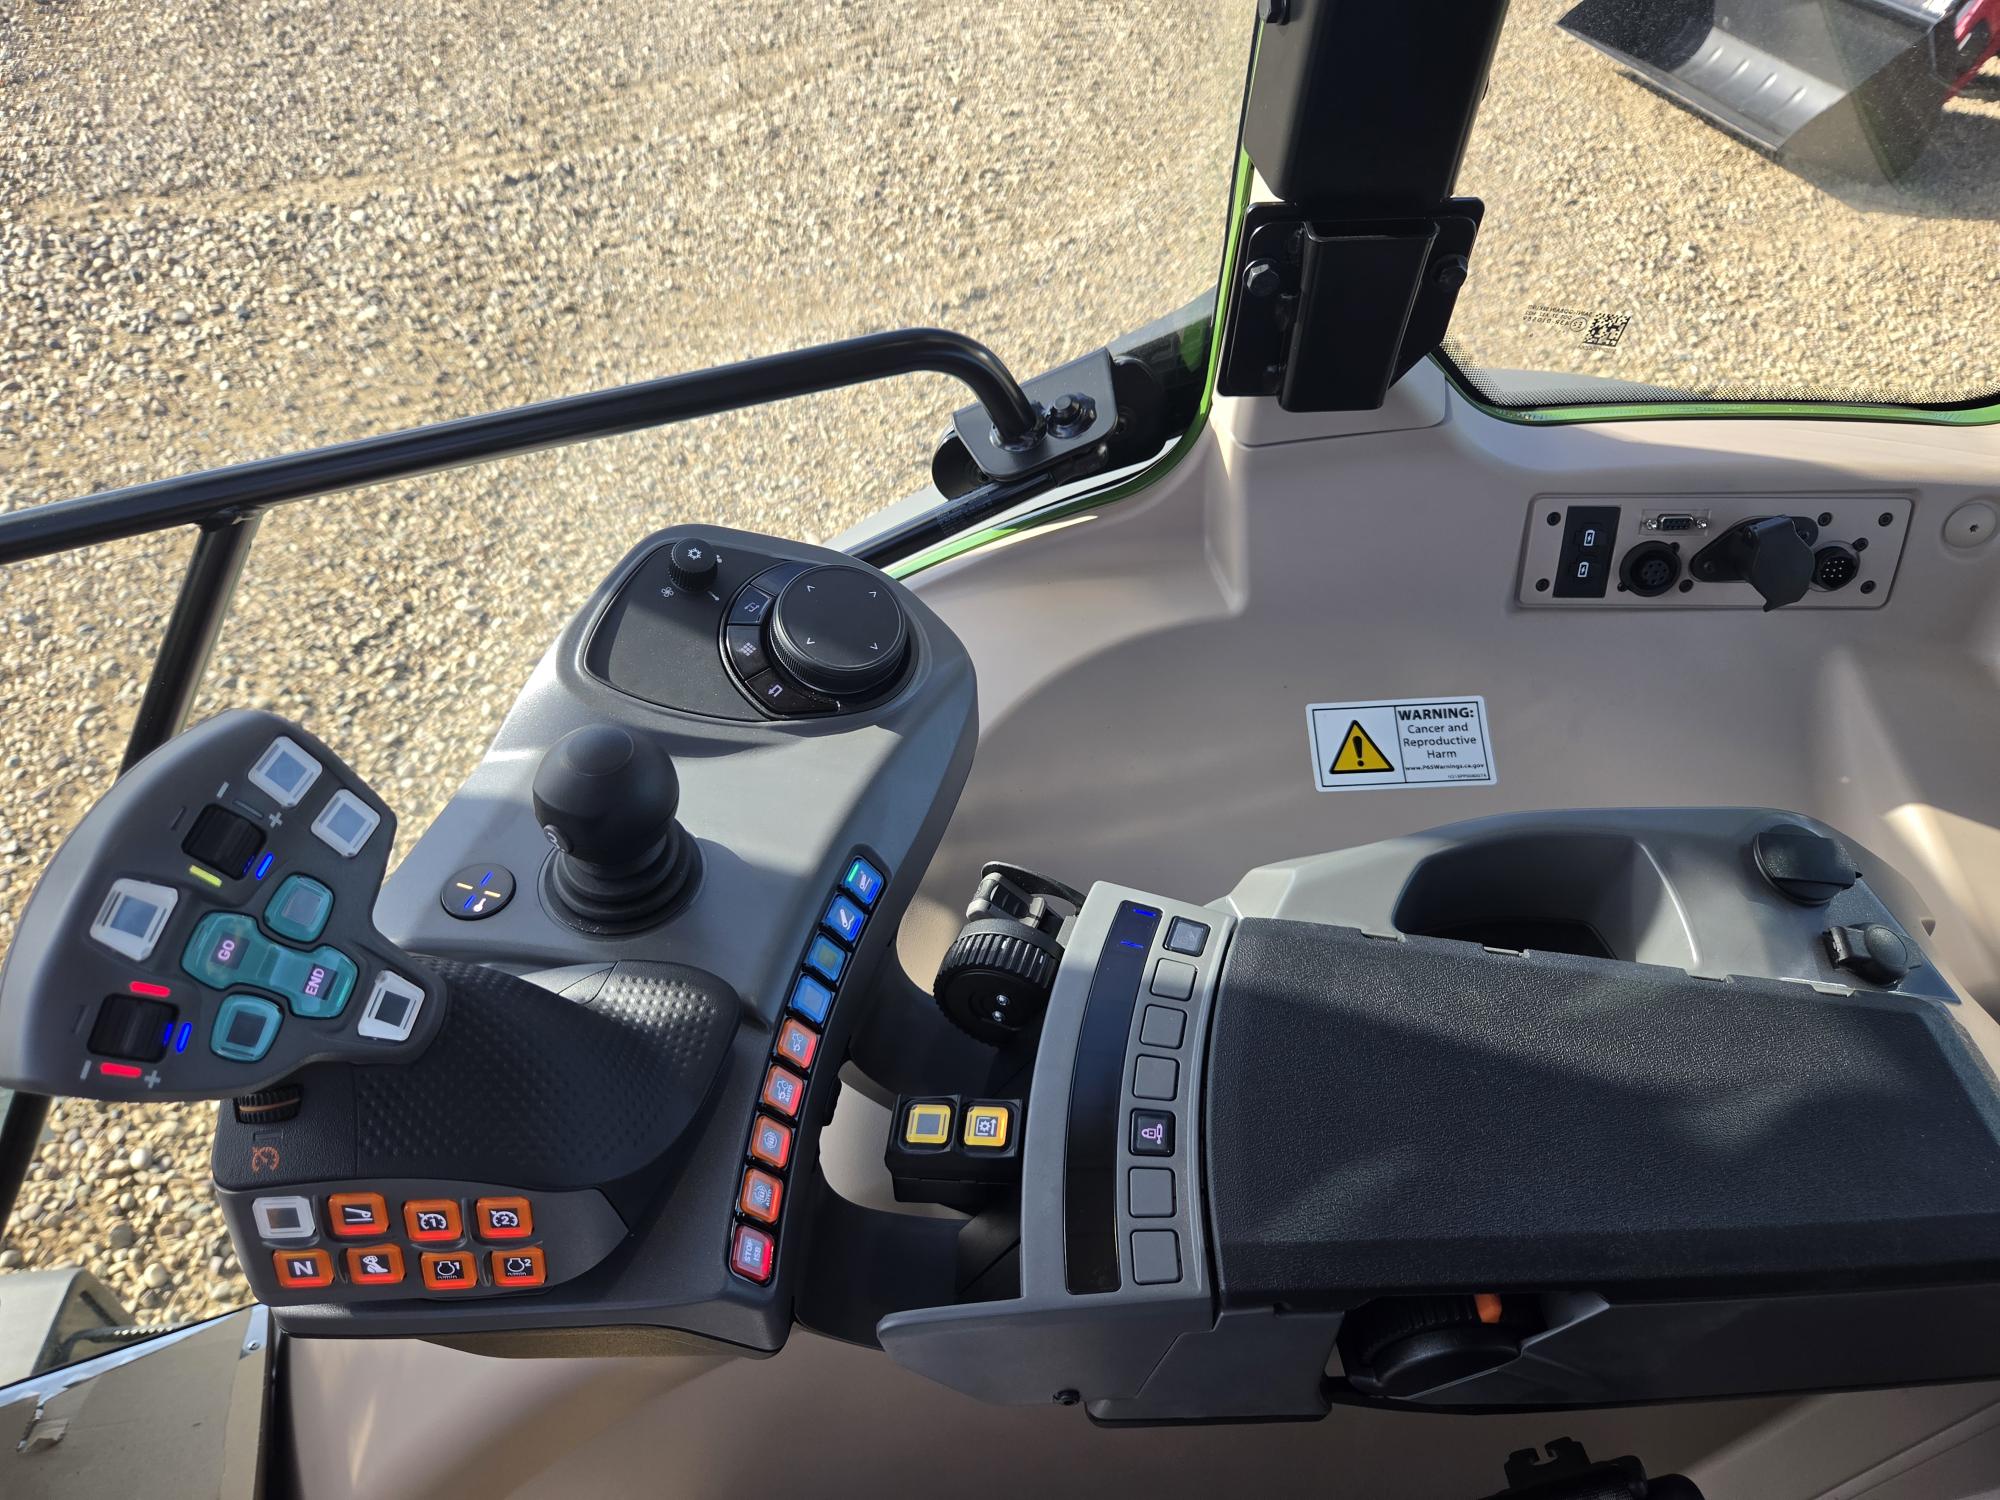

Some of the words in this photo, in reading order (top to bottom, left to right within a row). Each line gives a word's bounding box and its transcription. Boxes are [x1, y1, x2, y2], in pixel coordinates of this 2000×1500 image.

[1398, 707, 1474, 721] WARNING:
[1407, 724, 1445, 734] Cancer
[1448, 722, 1468, 732] and
[1403, 736, 1477, 748] Reproductive
[1427, 750, 1457, 759] Harm
[1405, 763, 1484, 771] www.P65Warnings.ca.gov
[218, 940, 235, 961] GO
[305, 968, 325, 996] END
[785, 1084, 793, 1102] AUTO
[429, 1218, 437, 1228] 1
[501, 1215, 510, 1225] 2
[744, 1239, 754, 1263] STOP
[293, 1260, 314, 1276] N
[453, 1262, 460, 1270] 1
[523, 1259, 532, 1267] 2
